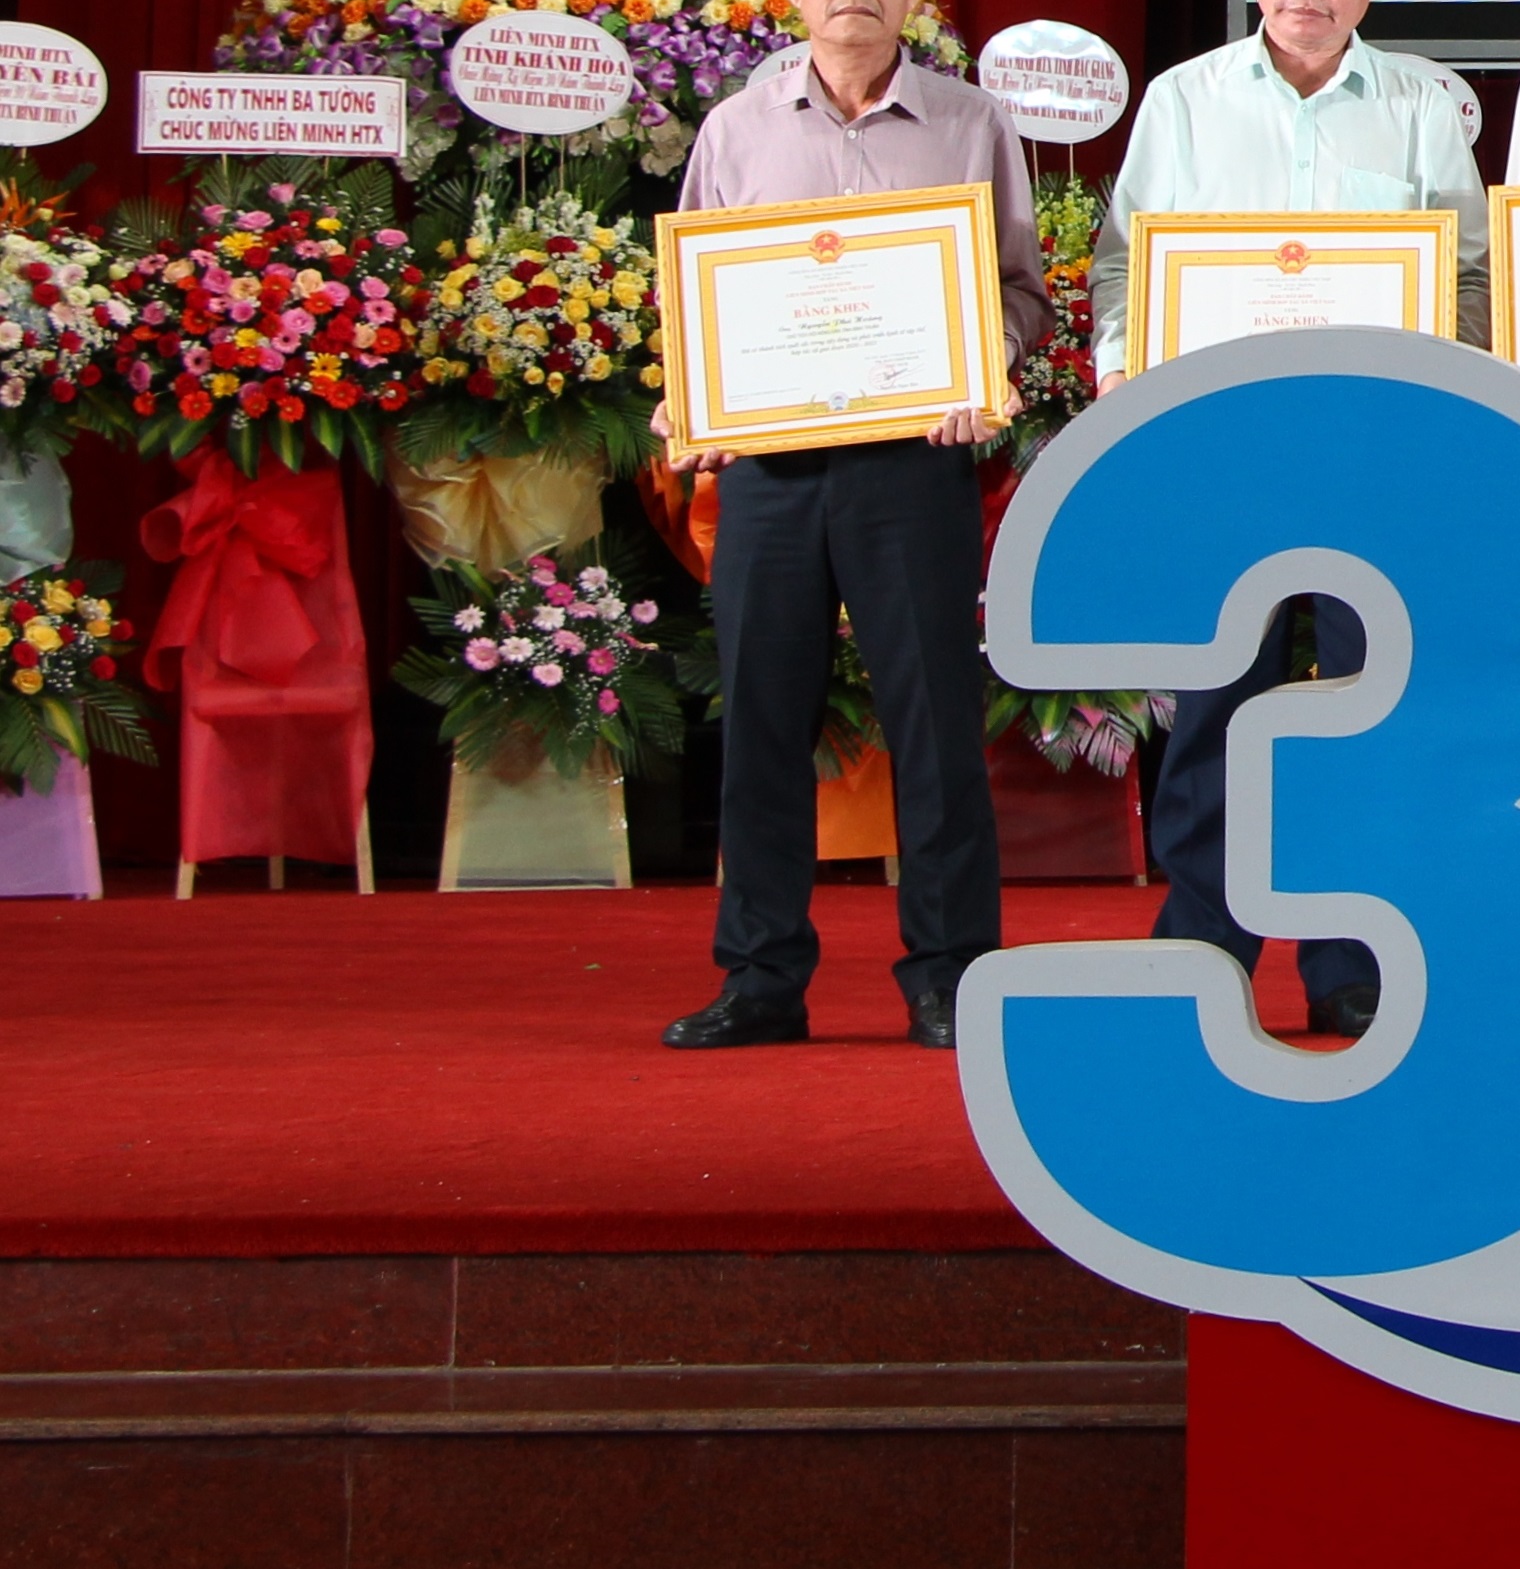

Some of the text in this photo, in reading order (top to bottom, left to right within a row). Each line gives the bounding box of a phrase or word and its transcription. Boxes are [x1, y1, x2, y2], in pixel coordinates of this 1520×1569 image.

[490, 26, 600, 52] LIÊN MINH HTX
[42, 48, 72, 64] HTX
[463, 42, 626, 76] TỈNH KHÁNH HÒA
[53, 67, 97, 87] BÁI
[168, 81, 375, 114] CÔNG TY TNHH BA TƯỜNG
[161, 115, 383, 144] CHÚC MỪNG LIÊN MINH HTX
[794, 302, 870, 318] BẰNG KHEN
[1254, 313, 1329, 326] BẰNG KHEN
